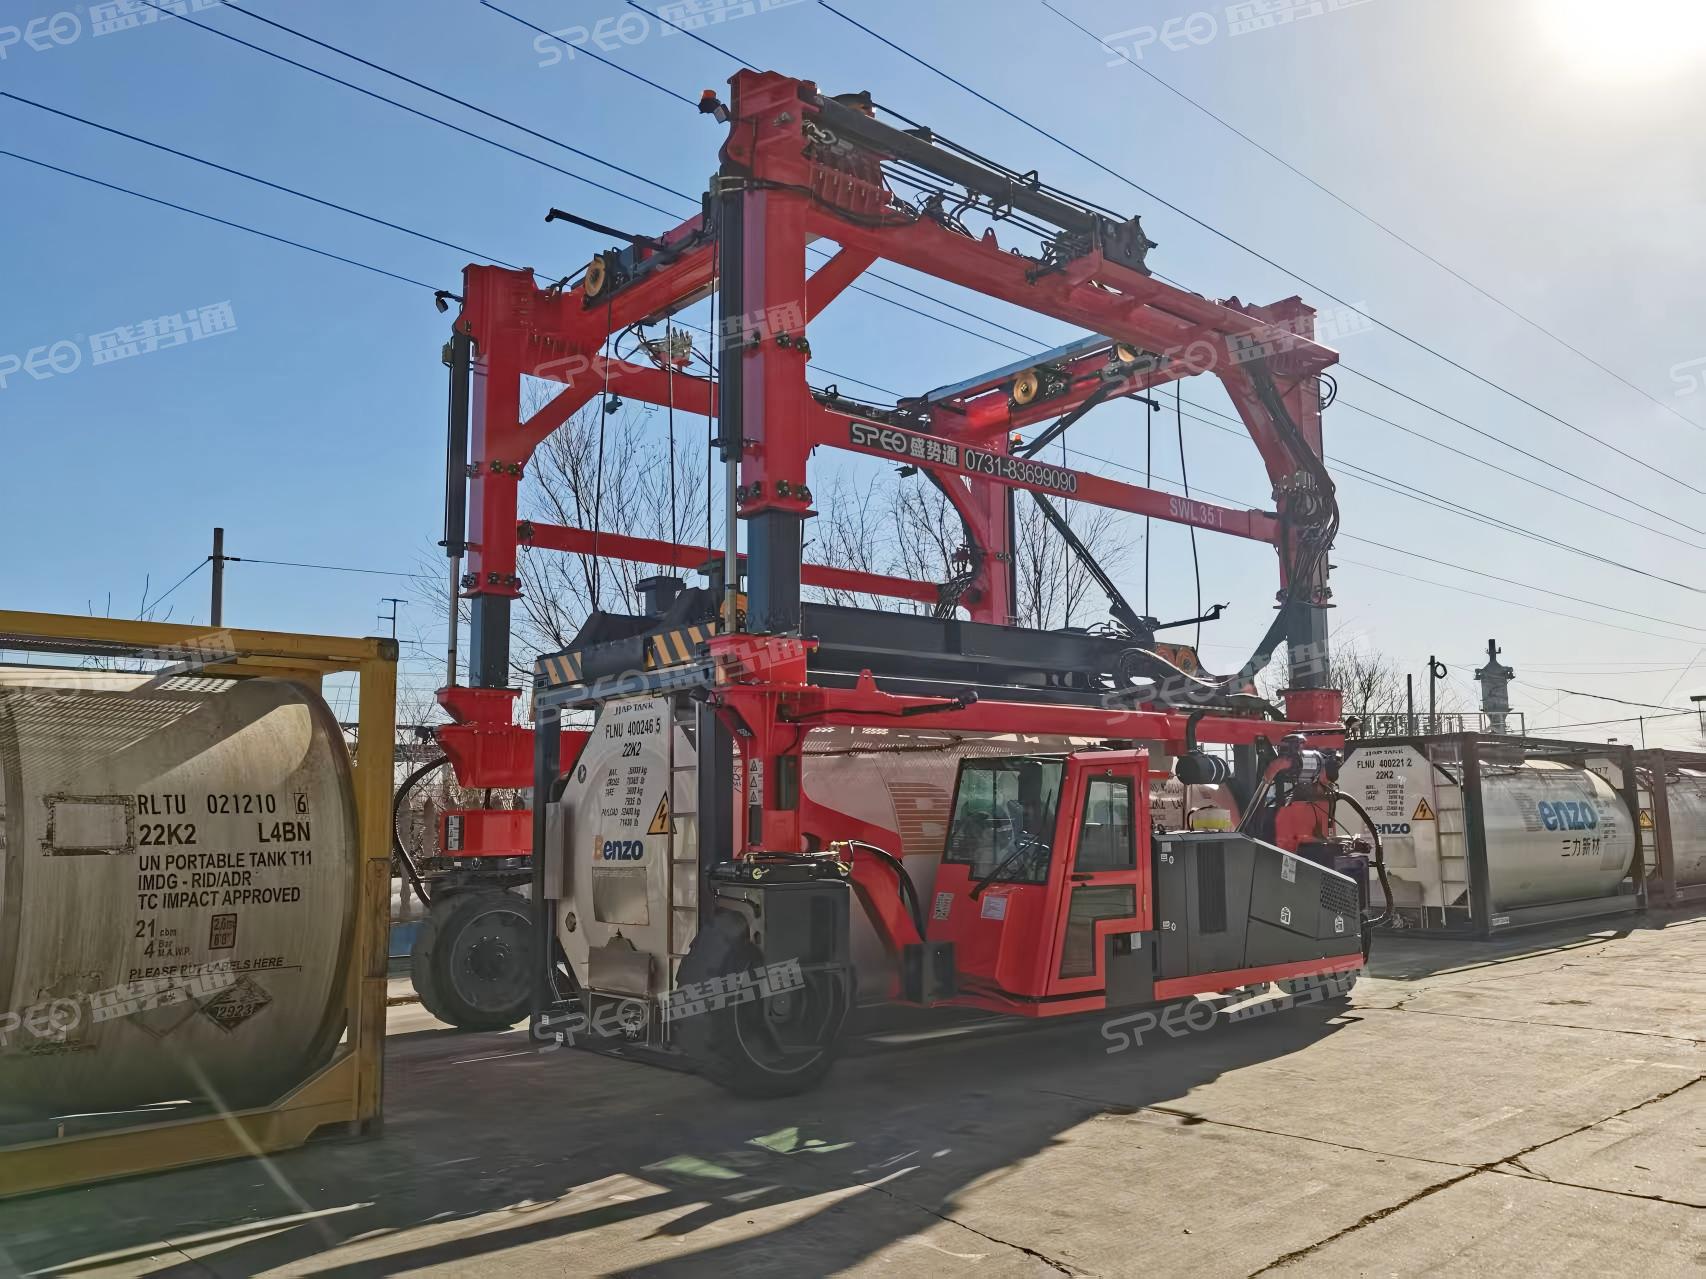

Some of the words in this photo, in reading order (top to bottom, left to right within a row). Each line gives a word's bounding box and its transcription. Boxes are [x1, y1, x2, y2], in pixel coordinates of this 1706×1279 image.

[852, 423, 907, 453] SPEO
[910, 437, 958, 466] 盛势通
[965, 449, 1077, 493] 0731-83699090
[1169, 497, 1198, 521] SWL
[605, 723, 624, 739] FLNU
[627, 718, 654, 736] 400246
[622, 741, 642, 757] 22K2
[1357, 760, 1375, 769] FLNU
[1379, 759, 1404, 768] 400221
[1375, 770, 1394, 780] 22K2
[137, 794, 186, 815] RLTU
[207, 793, 277, 814] 021210
[295, 793, 308, 814] 6
[139, 823, 197, 846] 22K2
[258, 822, 311, 842] L4BN
[139, 855, 160, 871] UN
[165, 853, 245, 871] PORTABLE
[250, 851, 287, 867] TANK
[291, 850, 312, 866] T11
[138, 873, 178, 891] IMDG
[191, 871, 252, 888] RID/ADR
[138, 893, 158, 910] TC
[163, 890, 219, 909] IMPACT
[222, 887, 301, 906] APPROVED
[135, 919, 156, 938] 21
[160, 928, 177, 937] cbm
[144, 940, 154, 958] 4
[129, 966, 177, 980] PLEASE
[253, 957, 285, 969] HERE
